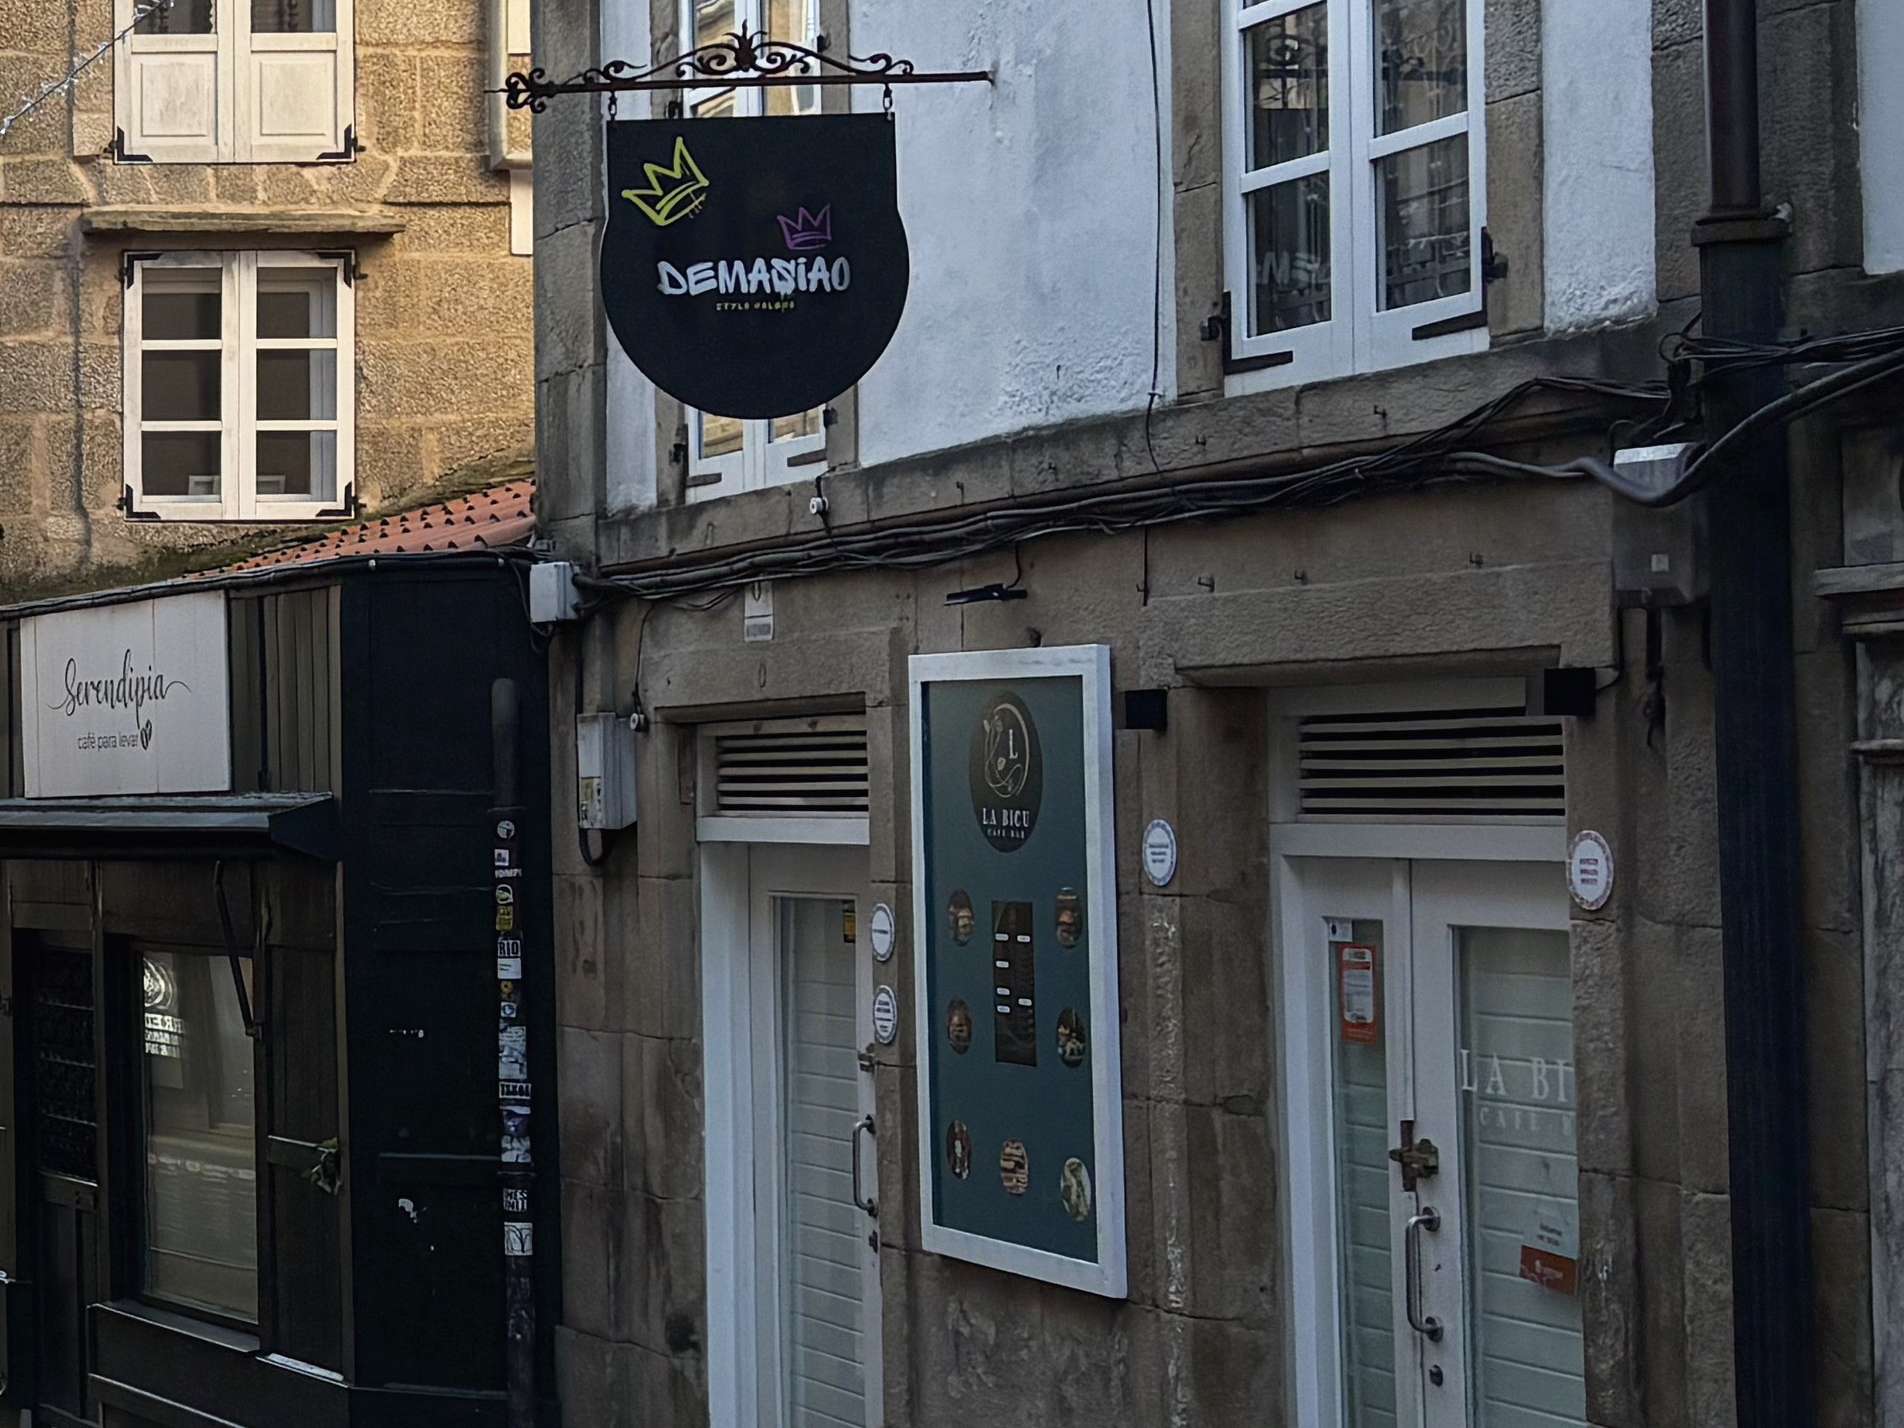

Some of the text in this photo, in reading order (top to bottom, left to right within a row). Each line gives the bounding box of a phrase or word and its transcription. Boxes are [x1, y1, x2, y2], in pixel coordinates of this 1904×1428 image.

[47, 648, 192, 729] Serendipia
[97, 735, 117, 751] para
[982, 808, 1030, 828] LA BICU
[1460, 1049, 1507, 1095] LA
